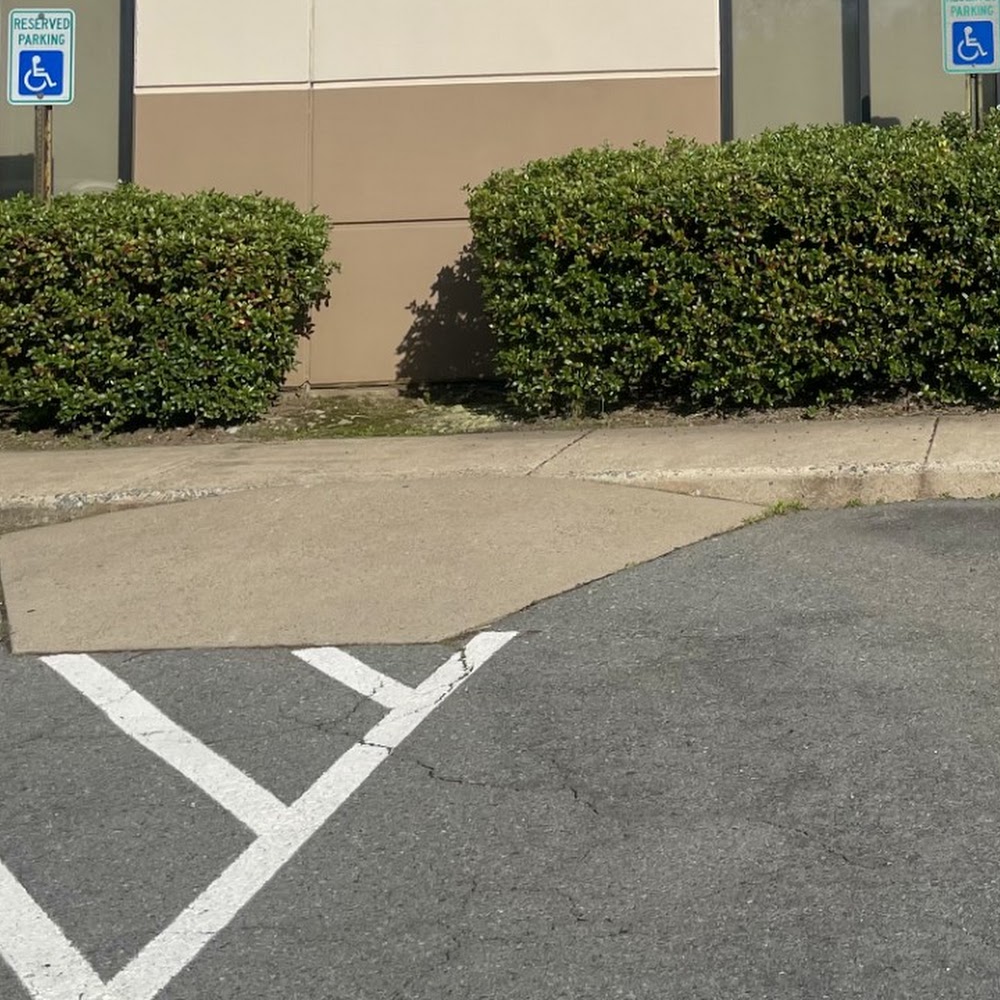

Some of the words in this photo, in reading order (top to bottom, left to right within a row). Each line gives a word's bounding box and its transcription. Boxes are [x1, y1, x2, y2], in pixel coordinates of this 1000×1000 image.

[951, 6, 994, 17] PARKING
[14, 17, 70, 30] RESERVED
[18, 34, 65, 45] PARKING
